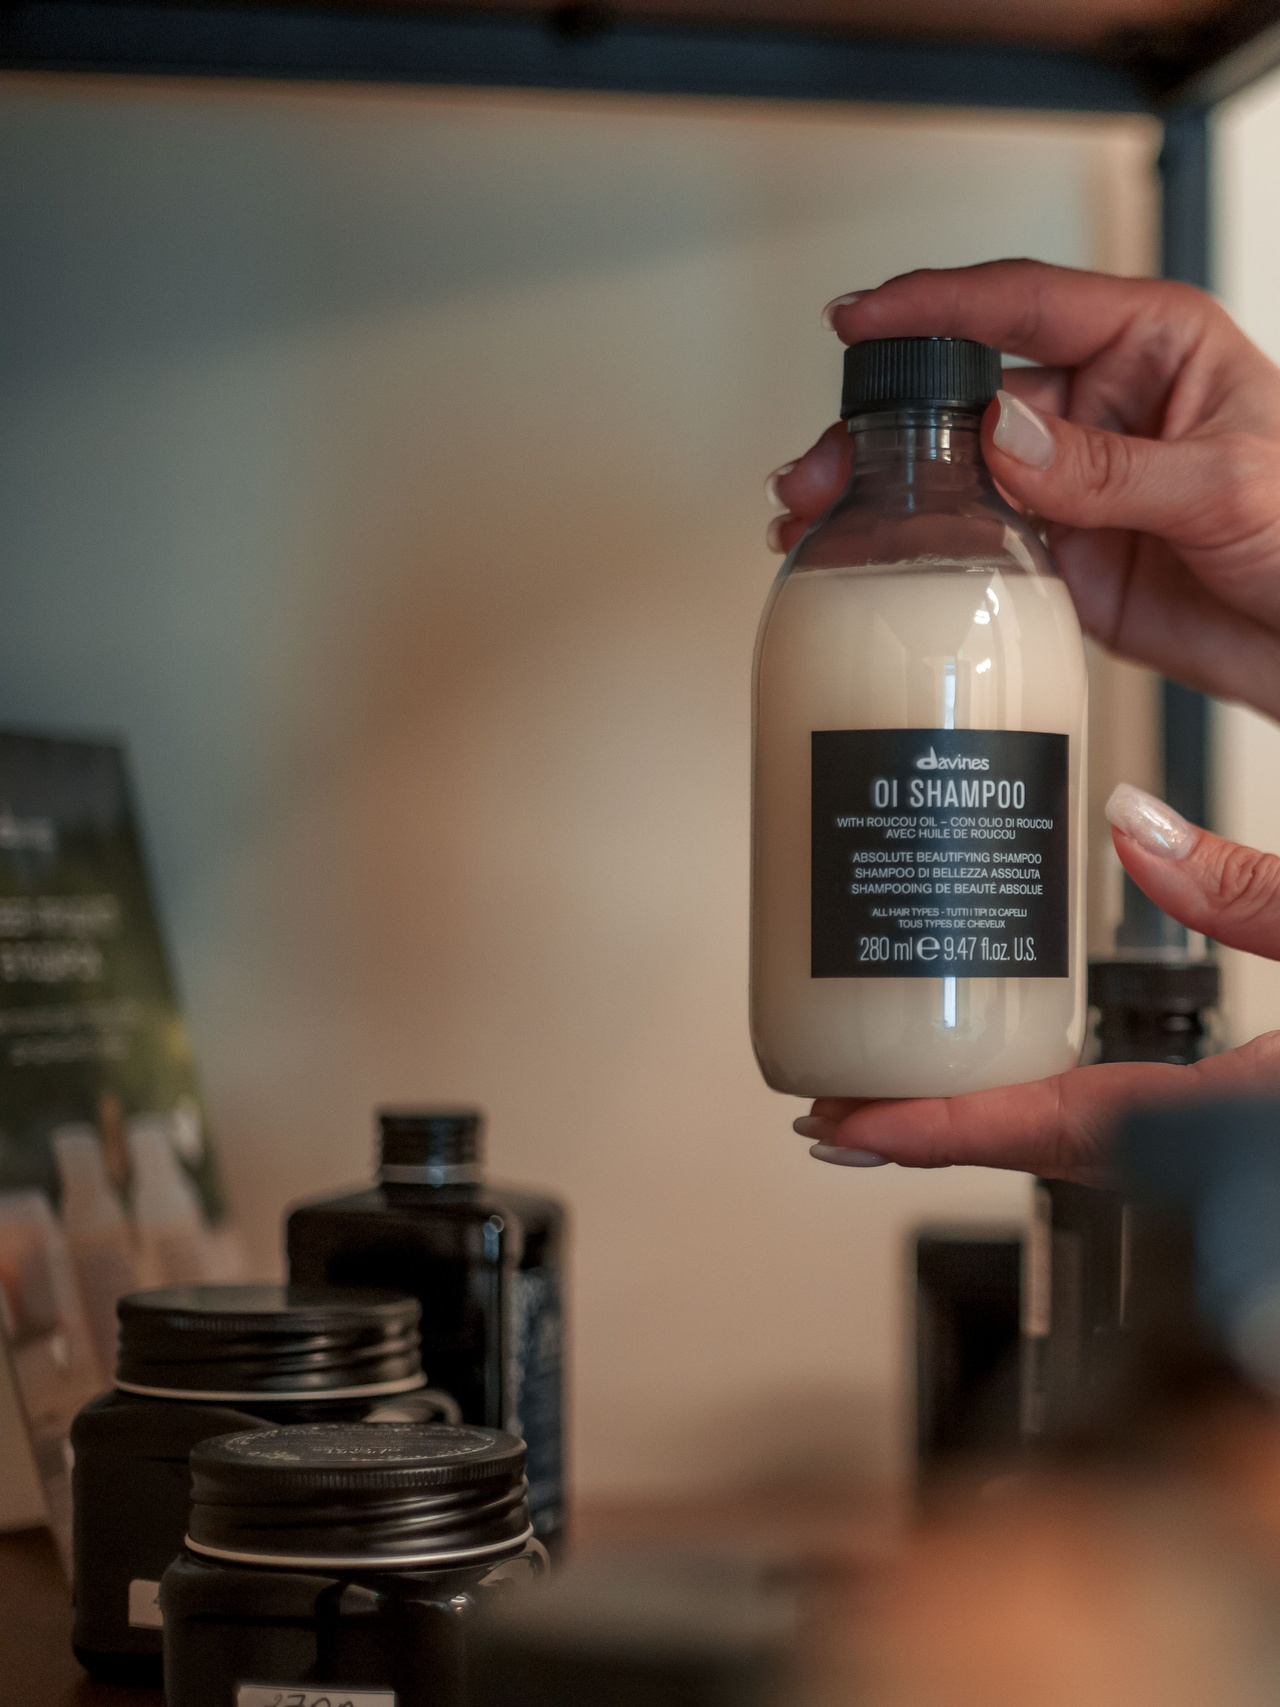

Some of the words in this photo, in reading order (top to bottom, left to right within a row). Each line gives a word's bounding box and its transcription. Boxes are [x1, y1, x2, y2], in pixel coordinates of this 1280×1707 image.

[917, 747, 989, 770] davines
[875, 779, 897, 807] OI
[911, 780, 1024, 808] SHAMPOO
[837, 818, 864, 827] WITH
[867, 817, 916, 828] ROUCOU
[919, 817, 938, 828] OIL
[950, 817, 976, 828] CON
[978, 817, 1004, 828] OLIO
[1004, 818, 1015, 828] DI
[1017, 818, 1053, 829] ROUCOU
[886, 829, 916, 838] AVEC
[919, 828, 951, 838] HUILE
[953, 829, 968, 838] DE
[971, 829, 1015, 839] ROUCOU
[853, 852, 913, 862] ABSOLUTE
[917, 852, 990, 863] BEAUTIFYING
[993, 852, 1041, 864] SHAMPOO
[855, 867, 915, 878] SHAMPOO
[918, 868, 929, 878] DI
[933, 868, 988, 878] BELLEZZA
[991, 868, 1040, 879] ASSOLUTA
[852, 883, 932, 894] SHAMPOOING
[936, 883, 951, 893] DE
[954, 882, 997, 894] BEAUTÉ
[999, 884, 1043, 894] ABSOLUE
[872, 908, 888, 916] ALL
[889, 908, 910, 916] HAIR
[912, 908, 939, 916] TYPES
[946, 908, 968, 916] TUTTI
[974, 908, 987, 916] TIPI
[989, 908, 996, 916] DI
[998, 908, 1027, 917] CAPELLI
[899, 920, 923, 928] TOUS
[925, 919, 952, 928] TYPES
[954, 920, 965, 928] DE
[967, 920, 1005, 928] CHEVEUX
[860, 937, 889, 960] 280
[895, 937, 912, 960] ml
[944, 937, 977, 960] 9.47
[981, 937, 1010, 960] fl.oz.
[1015, 937, 1036, 961] U.S.
